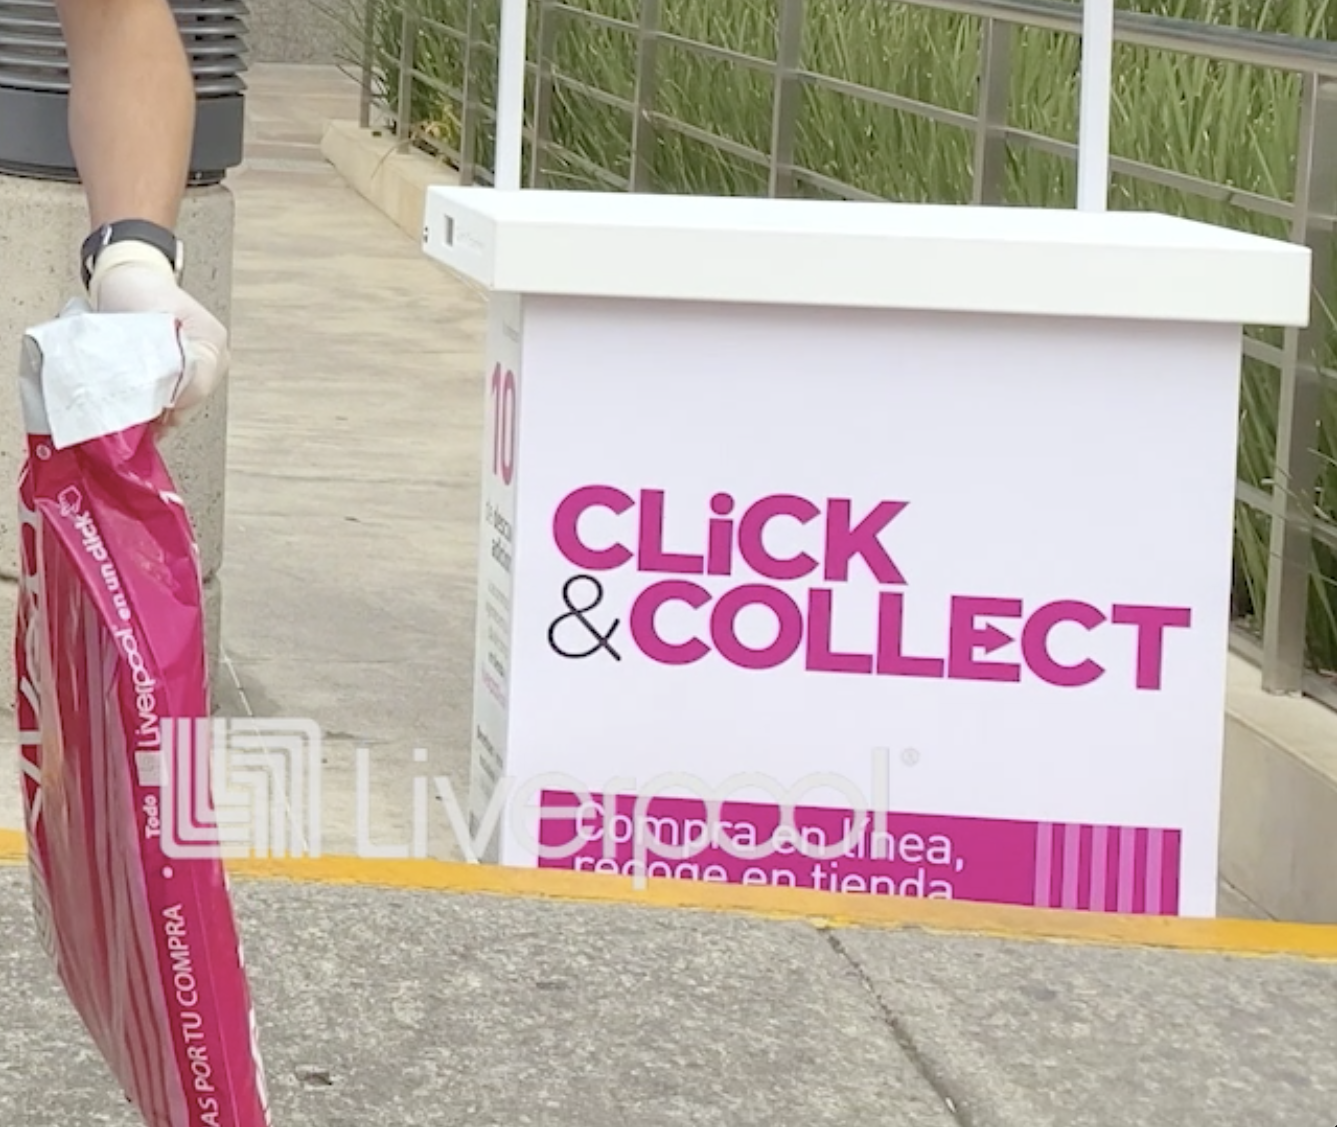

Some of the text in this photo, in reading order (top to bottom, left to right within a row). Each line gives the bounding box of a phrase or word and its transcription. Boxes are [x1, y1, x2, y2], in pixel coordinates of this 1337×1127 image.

[73, 512, 110, 566] click
[99, 560, 126, 599] un
[112, 590, 133, 622] en
[144, 794, 161, 840] Todo
[574, 799, 758, 854] Compra
[771, 822, 826, 856] en
[161, 903, 199, 1008] COMPRA
[180, 1011, 205, 1044] TU
[186, 1045, 216, 1093] POR
